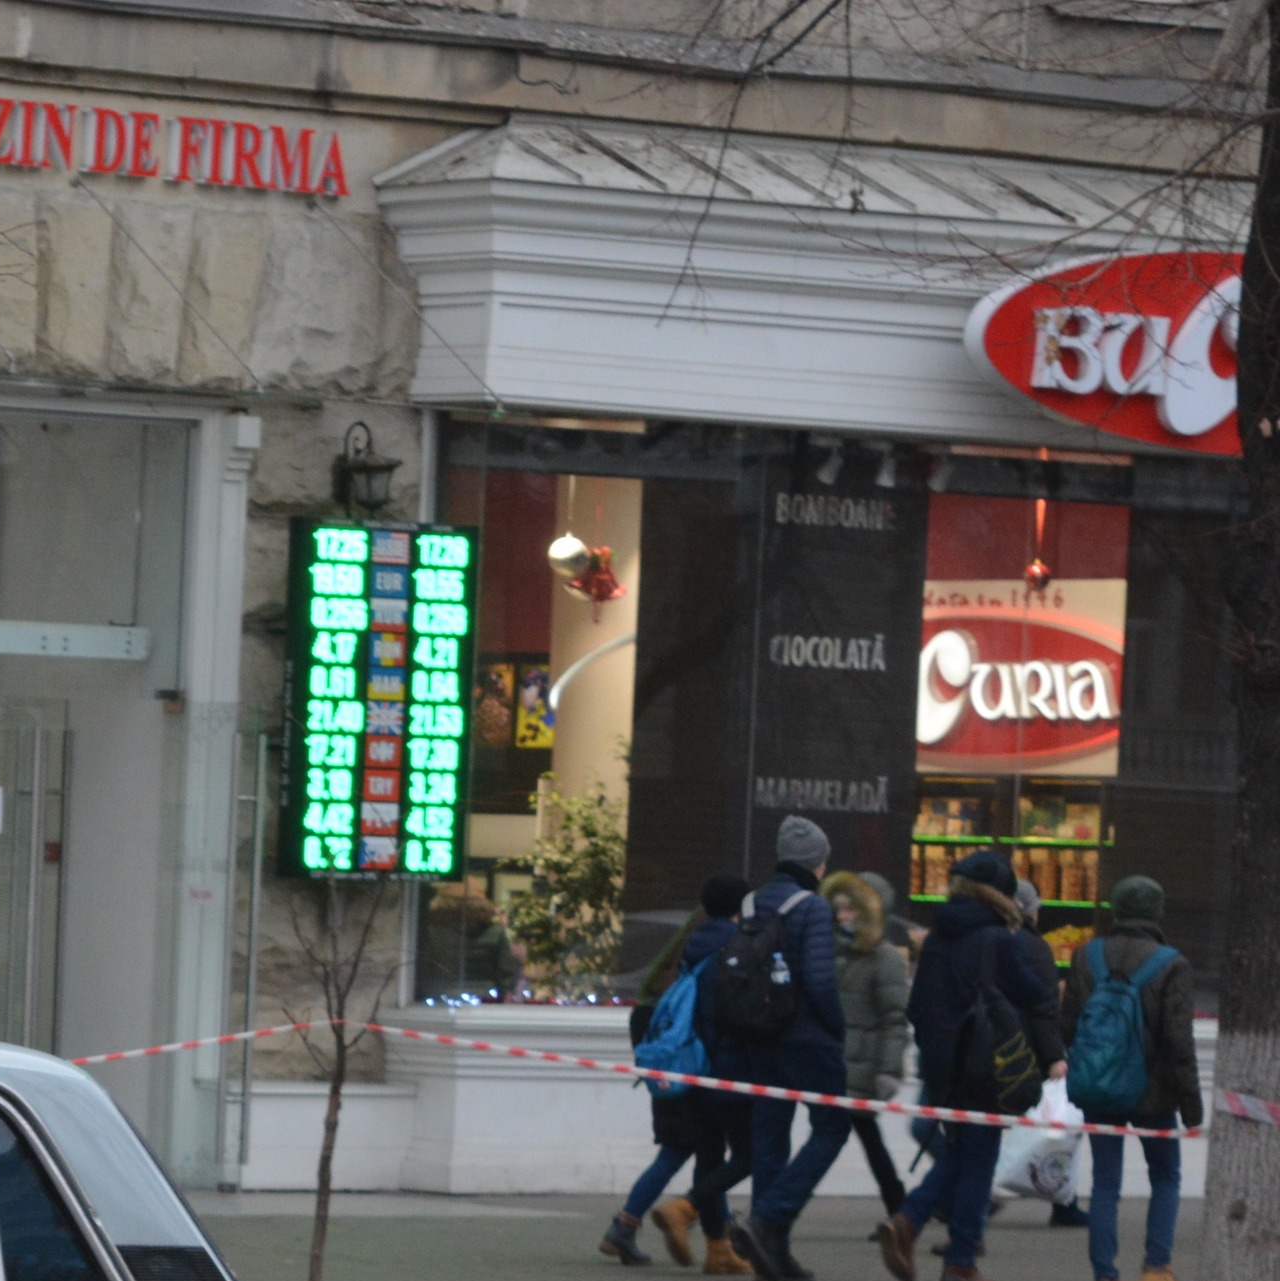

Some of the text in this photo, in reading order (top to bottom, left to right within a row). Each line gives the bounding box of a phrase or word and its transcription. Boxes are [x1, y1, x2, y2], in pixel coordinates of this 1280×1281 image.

[81, 109, 159, 178] DE
[171, 117, 350, 196] FIRMA
[376, 571, 403, 591] EUR
[413, 636, 459, 669] 4.21
[769, 632, 886, 672] CIOCOLATĂ
[305, 734, 356, 767] 17.21
